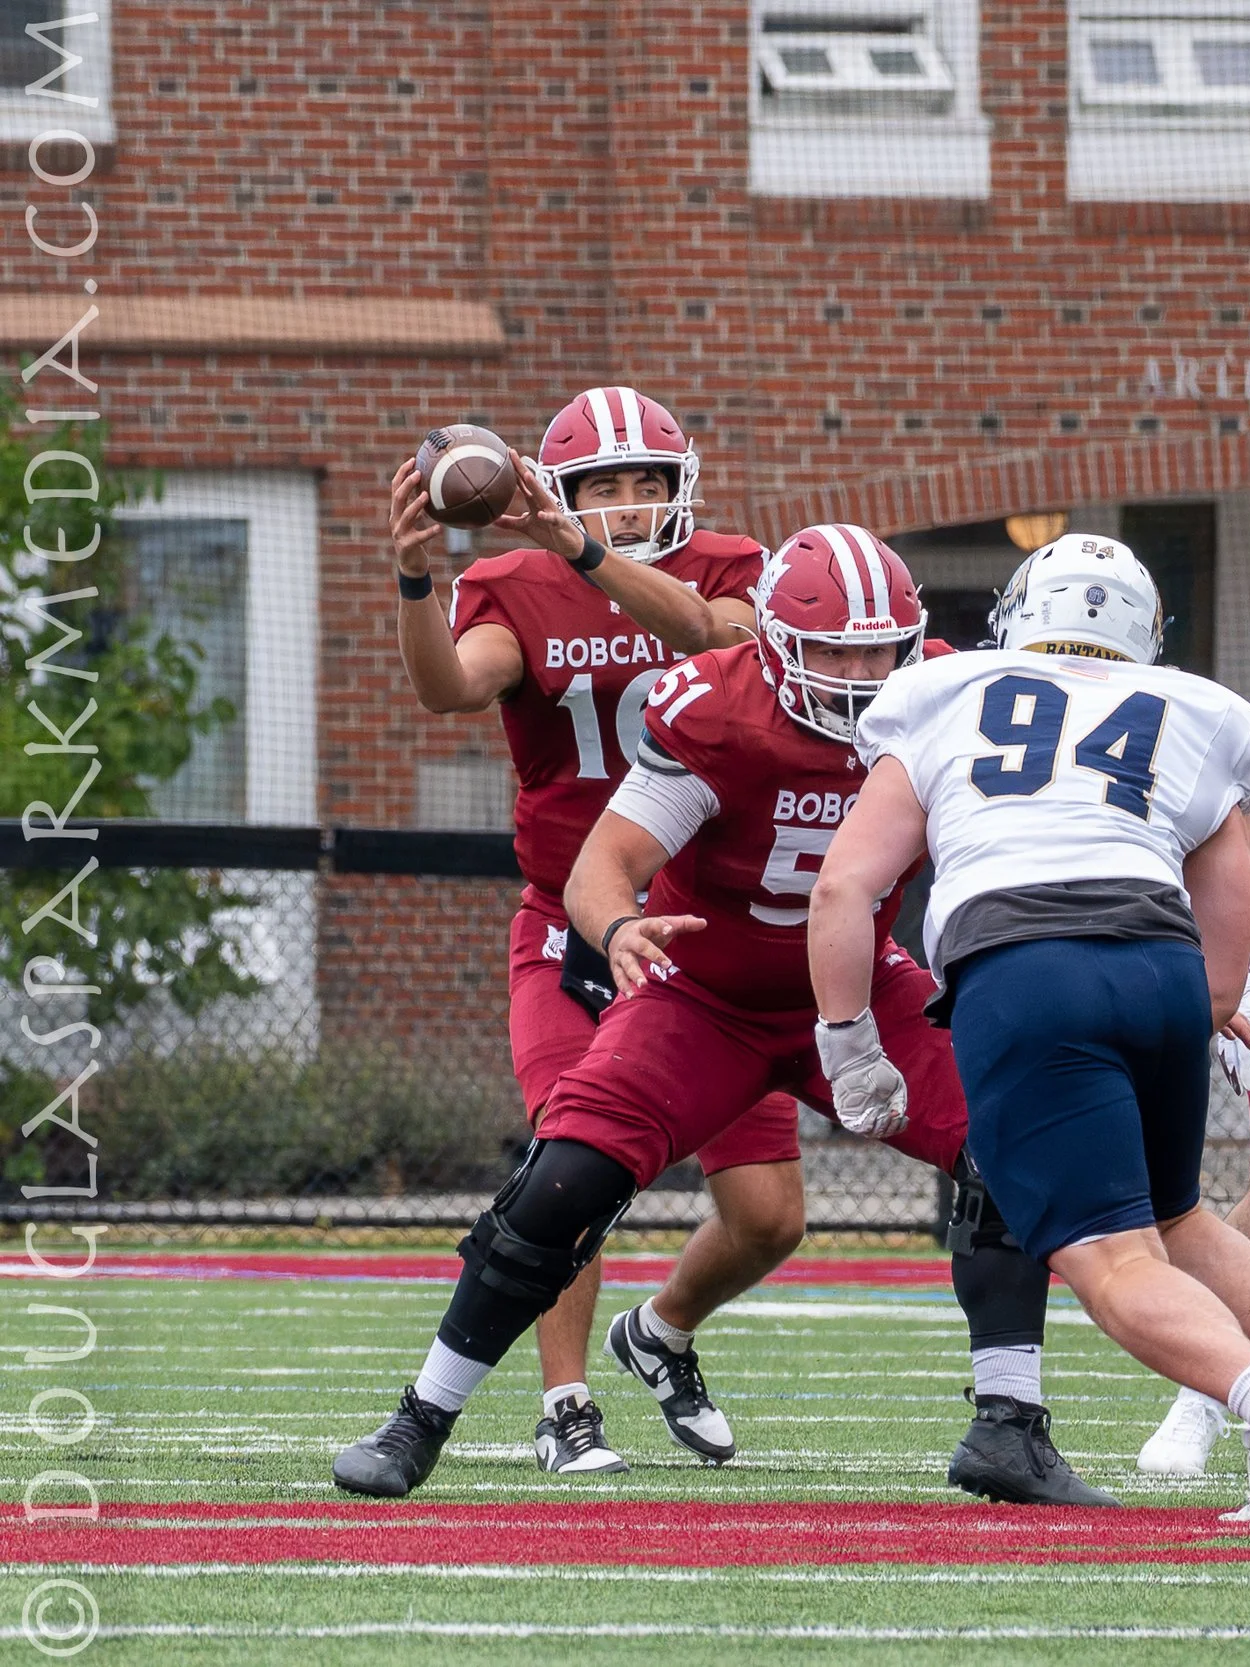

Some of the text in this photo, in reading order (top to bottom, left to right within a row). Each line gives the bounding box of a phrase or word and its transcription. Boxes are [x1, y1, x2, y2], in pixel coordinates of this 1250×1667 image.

[1081, 541, 1114, 559] 94
[852, 619, 893, 632] Riddell
[648, 660, 713, 729] 51
[968, 673, 1169, 824] 94
